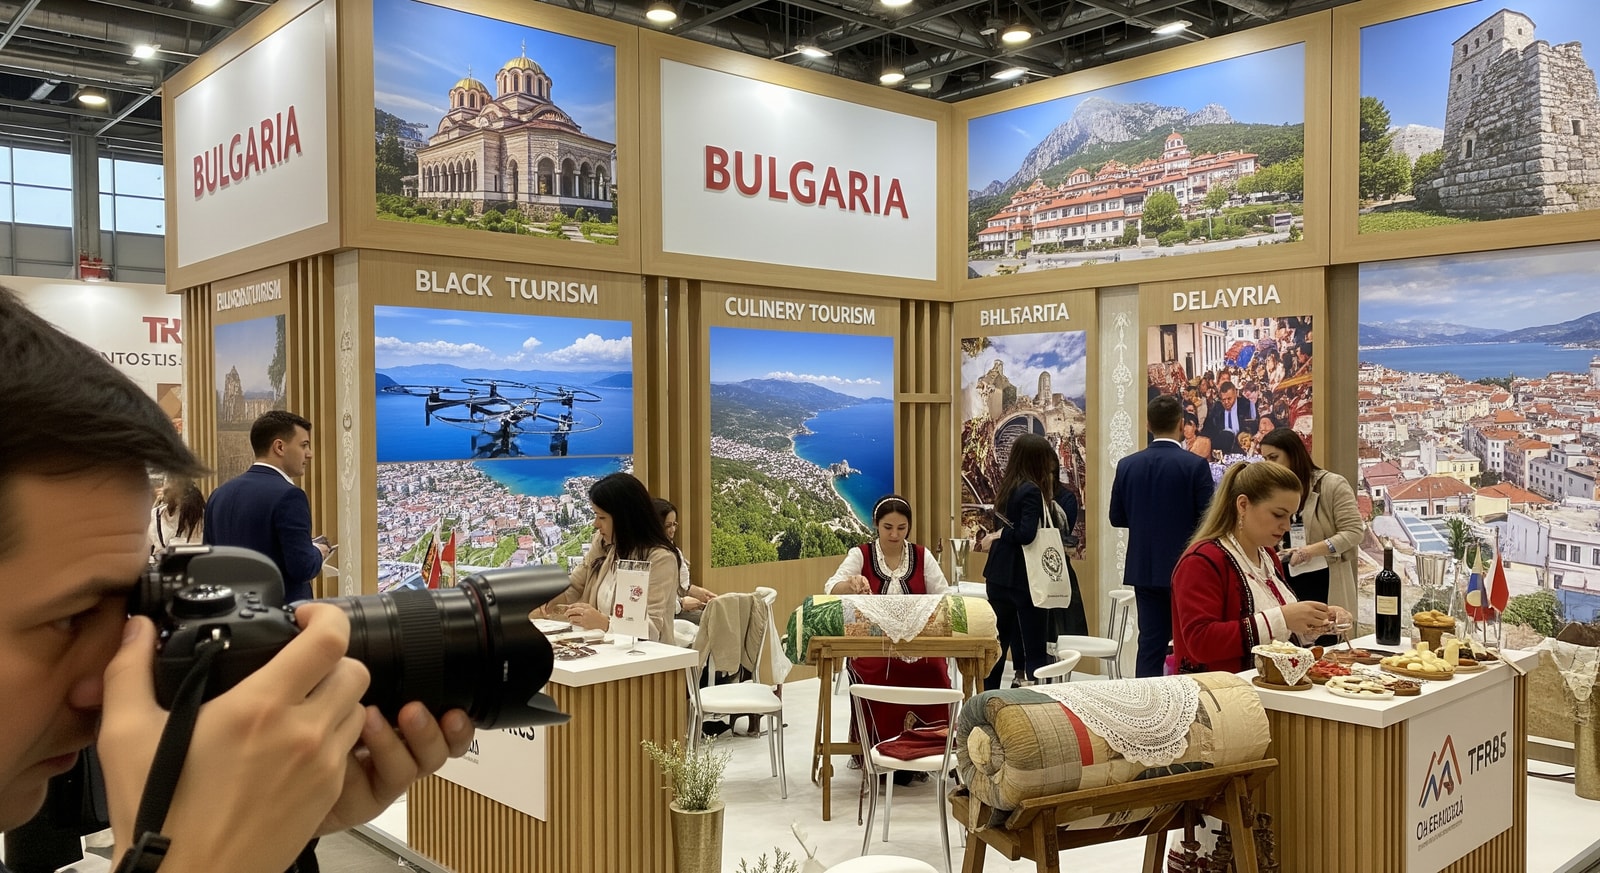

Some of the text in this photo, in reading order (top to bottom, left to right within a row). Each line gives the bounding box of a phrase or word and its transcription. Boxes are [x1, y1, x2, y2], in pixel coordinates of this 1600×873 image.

[193, 105, 302, 199] BULGARIA
[704, 144, 909, 219] BULGARIA
[415, 269, 493, 297] BLACK
[725, 296, 876, 326] CULINERY TOURISM
